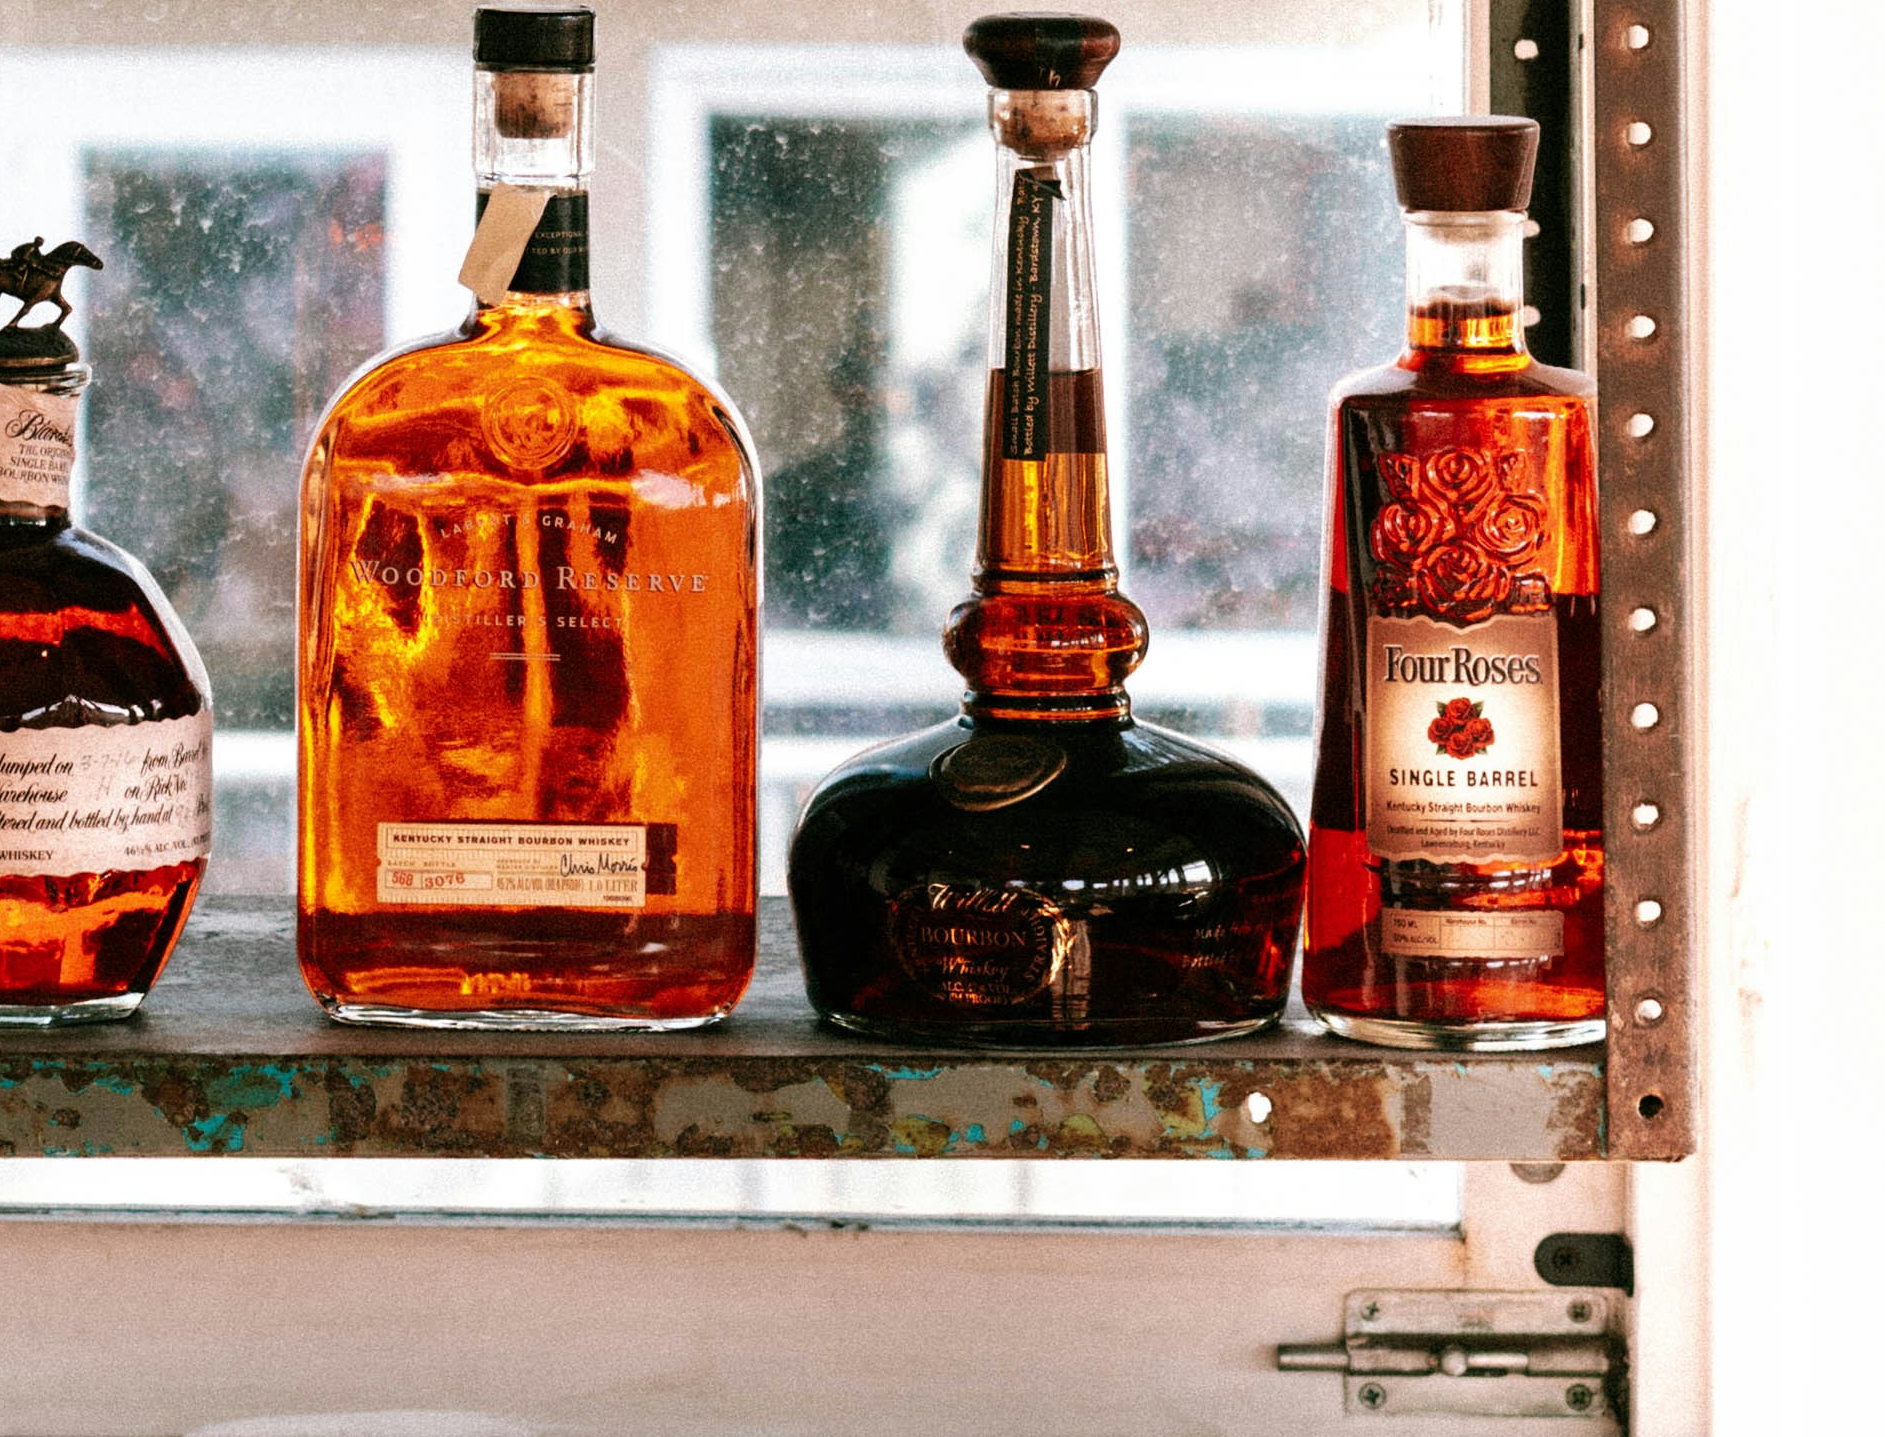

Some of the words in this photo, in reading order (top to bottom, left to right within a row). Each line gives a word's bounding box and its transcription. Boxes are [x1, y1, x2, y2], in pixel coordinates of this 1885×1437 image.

[350, 560, 541, 590] WOODFORD
[556, 565, 707, 592] RESERVE
[1384, 645, 1450, 683] Four
[1451, 646, 1541, 686] Roses
[1389, 768, 1456, 787] SINGLE
[1466, 769, 1539, 787] BARREL
[1386, 801, 1426, 815] Kentucky
[1428, 801, 1464, 815] Straight
[1465, 802, 1503, 813] Bourbon
[1505, 802, 1541, 816] Whiskey
[393, 834, 452, 844] KENTUCKY
[457, 835, 513, 845] STRAIGHT
[517, 836, 573, 846] BOURBON
[577, 837, 630, 847] WHISKEY
[920, 926, 1028, 948] BOURBON
[939, 957, 1011, 983] Whiskey
